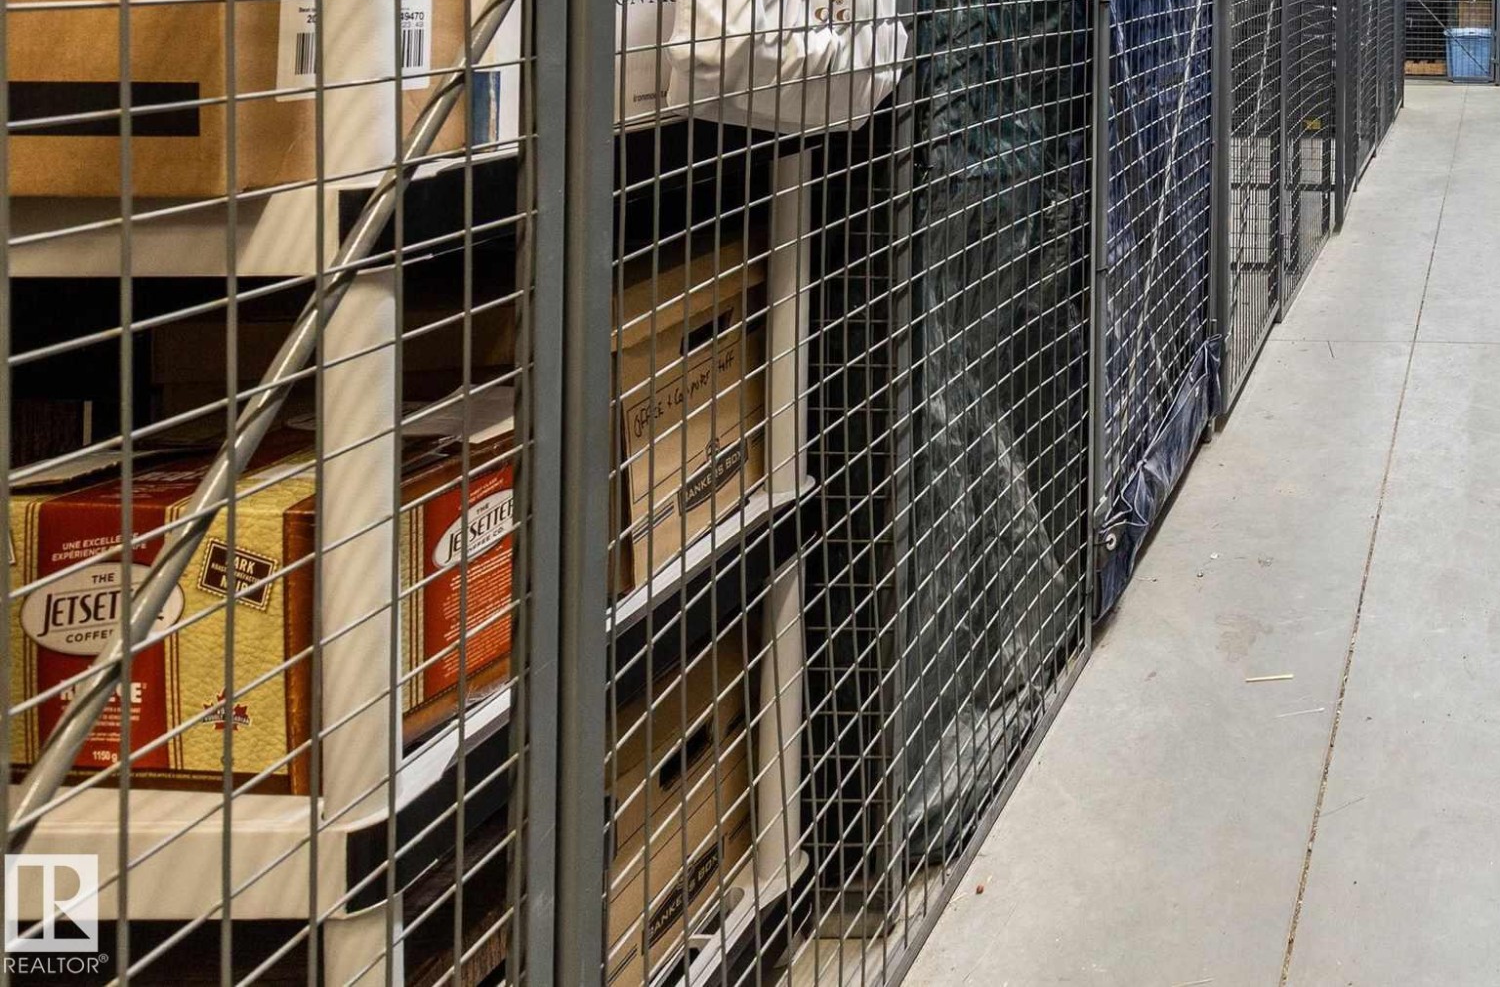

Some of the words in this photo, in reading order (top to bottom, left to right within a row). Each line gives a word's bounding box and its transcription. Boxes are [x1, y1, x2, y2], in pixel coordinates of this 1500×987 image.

[683, 463, 724, 502] ANKES
[444, 498, 514, 564] JESETTE
[62, 540, 82, 550] UNE
[52, 546, 108, 562] EXPÉRIENC
[226, 553, 255, 575] ARK
[92, 573, 115, 584] THE
[92, 751, 110, 761] 1150
